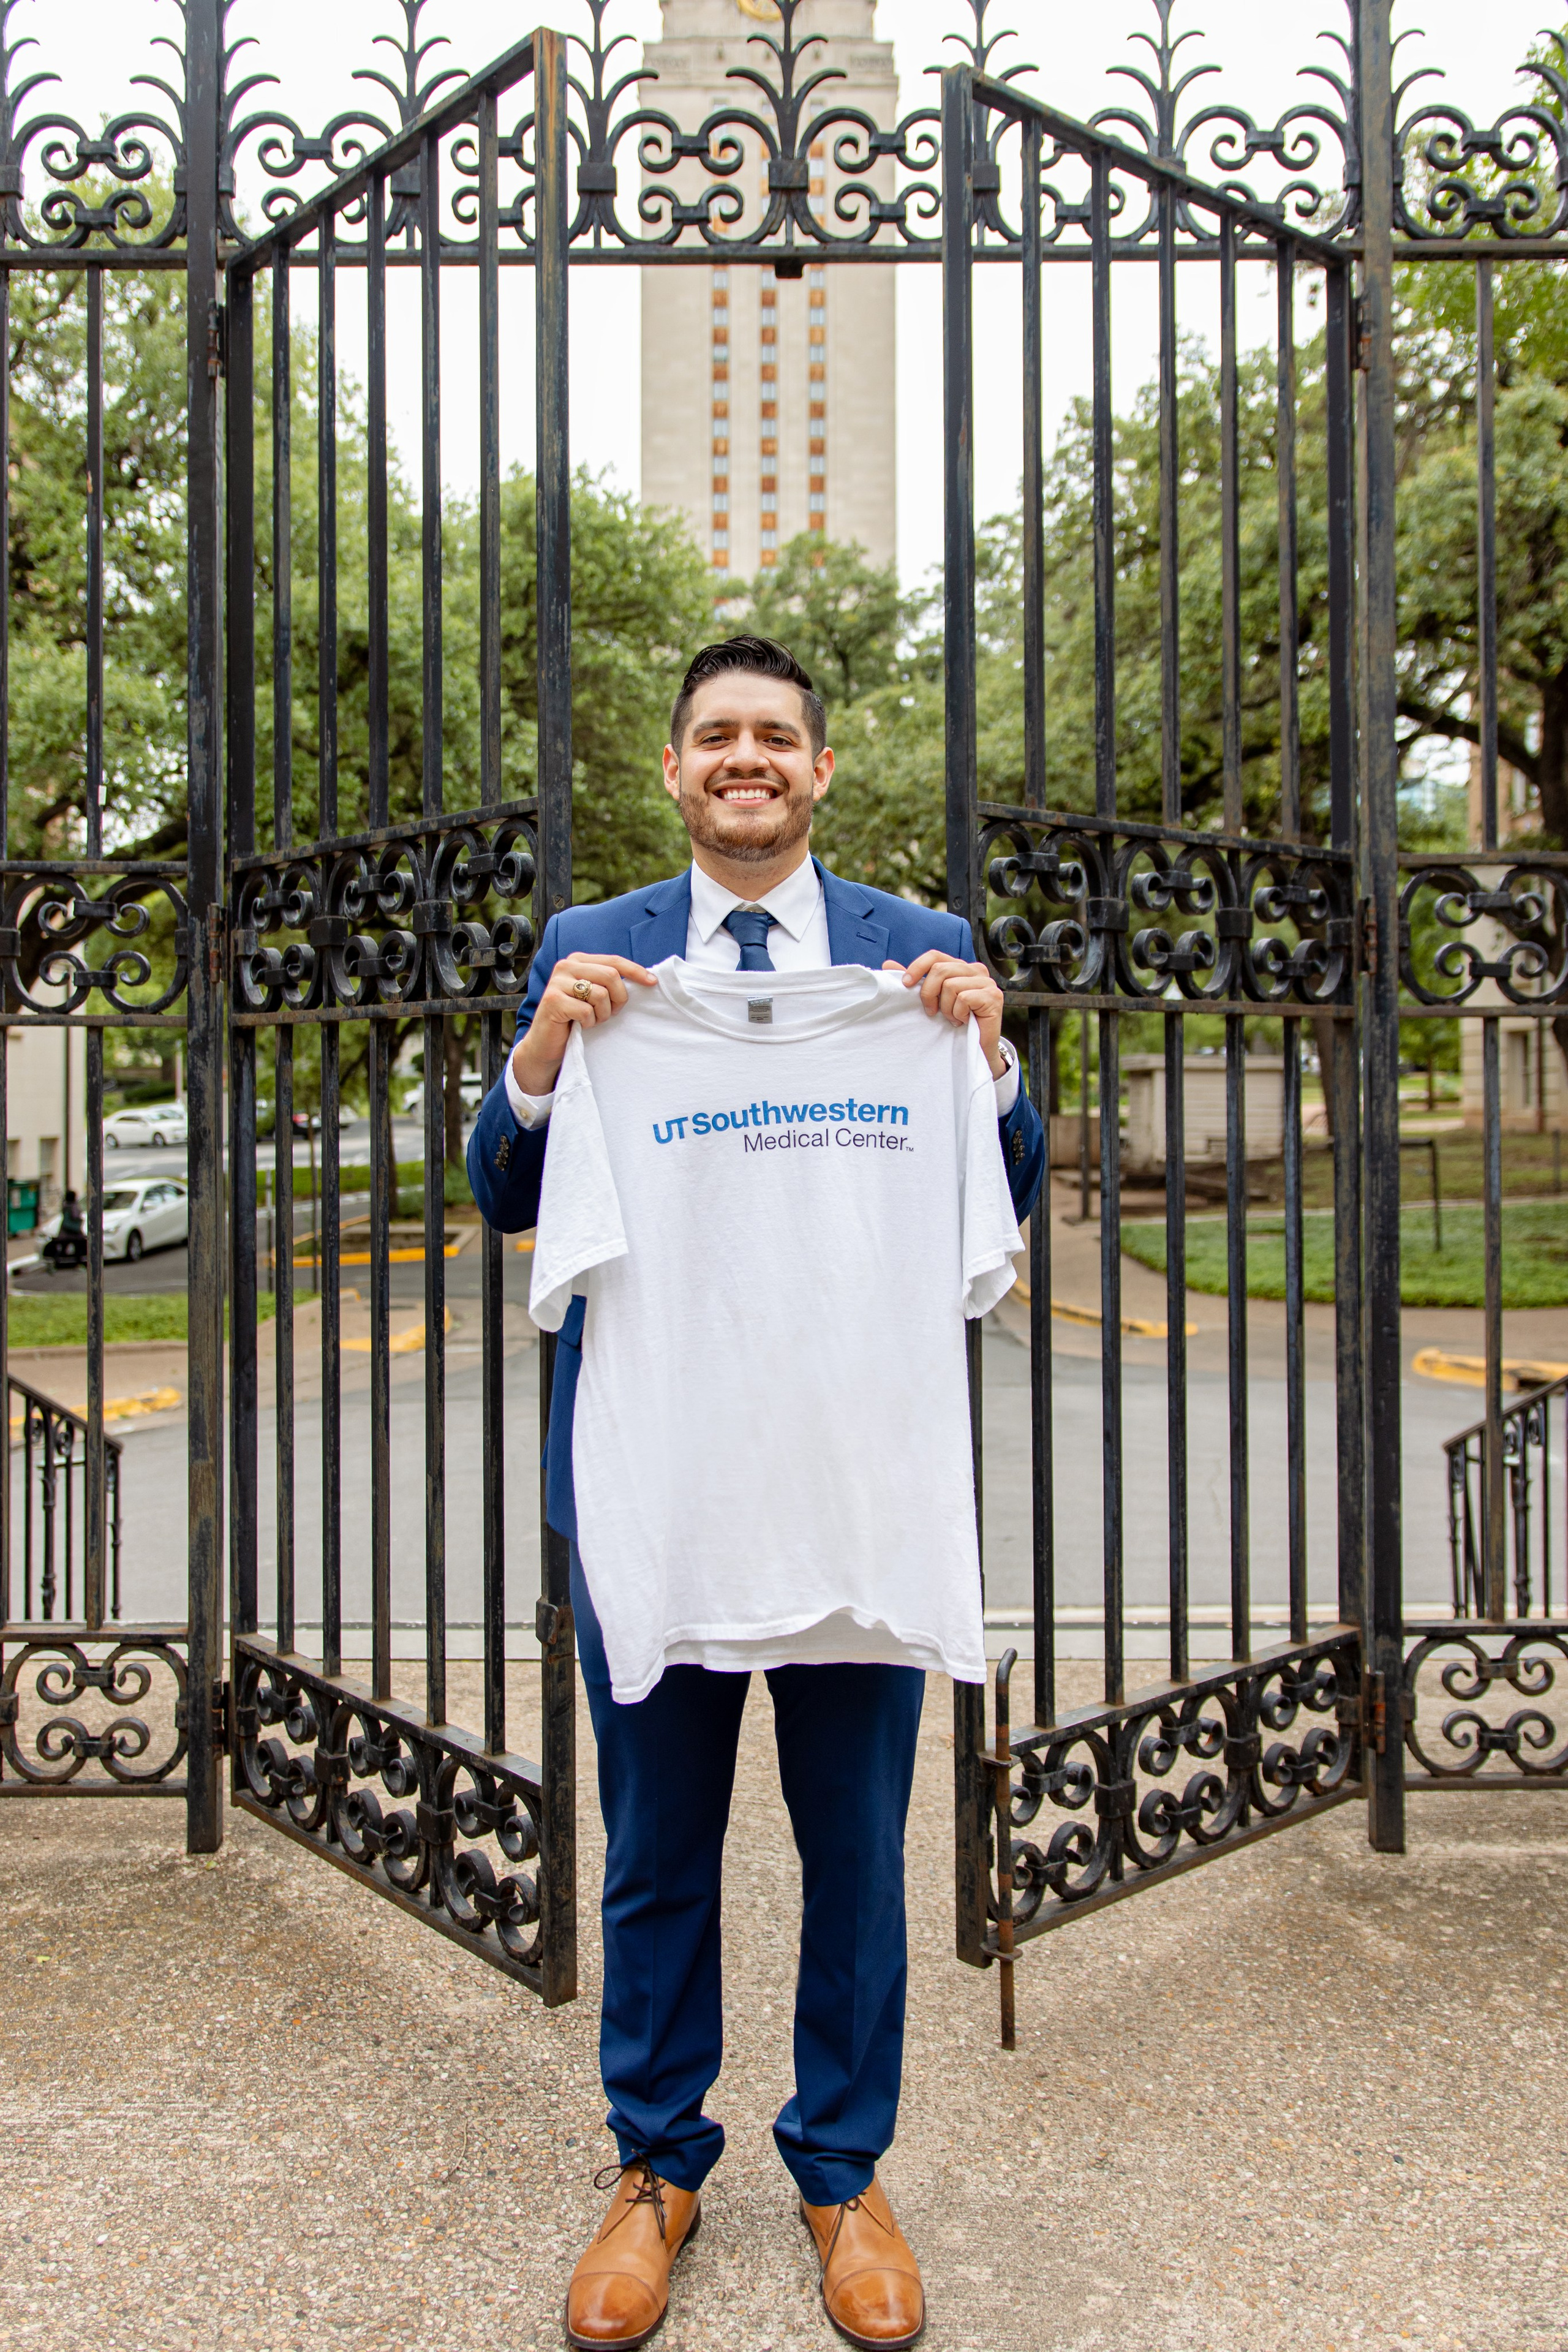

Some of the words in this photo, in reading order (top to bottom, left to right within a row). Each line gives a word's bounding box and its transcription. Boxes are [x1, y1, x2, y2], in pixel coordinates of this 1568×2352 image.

[653, 1117, 688, 1144] UT
[692, 1098, 909, 1135] Southwestern
[744, 1129, 829, 1153] Medical
